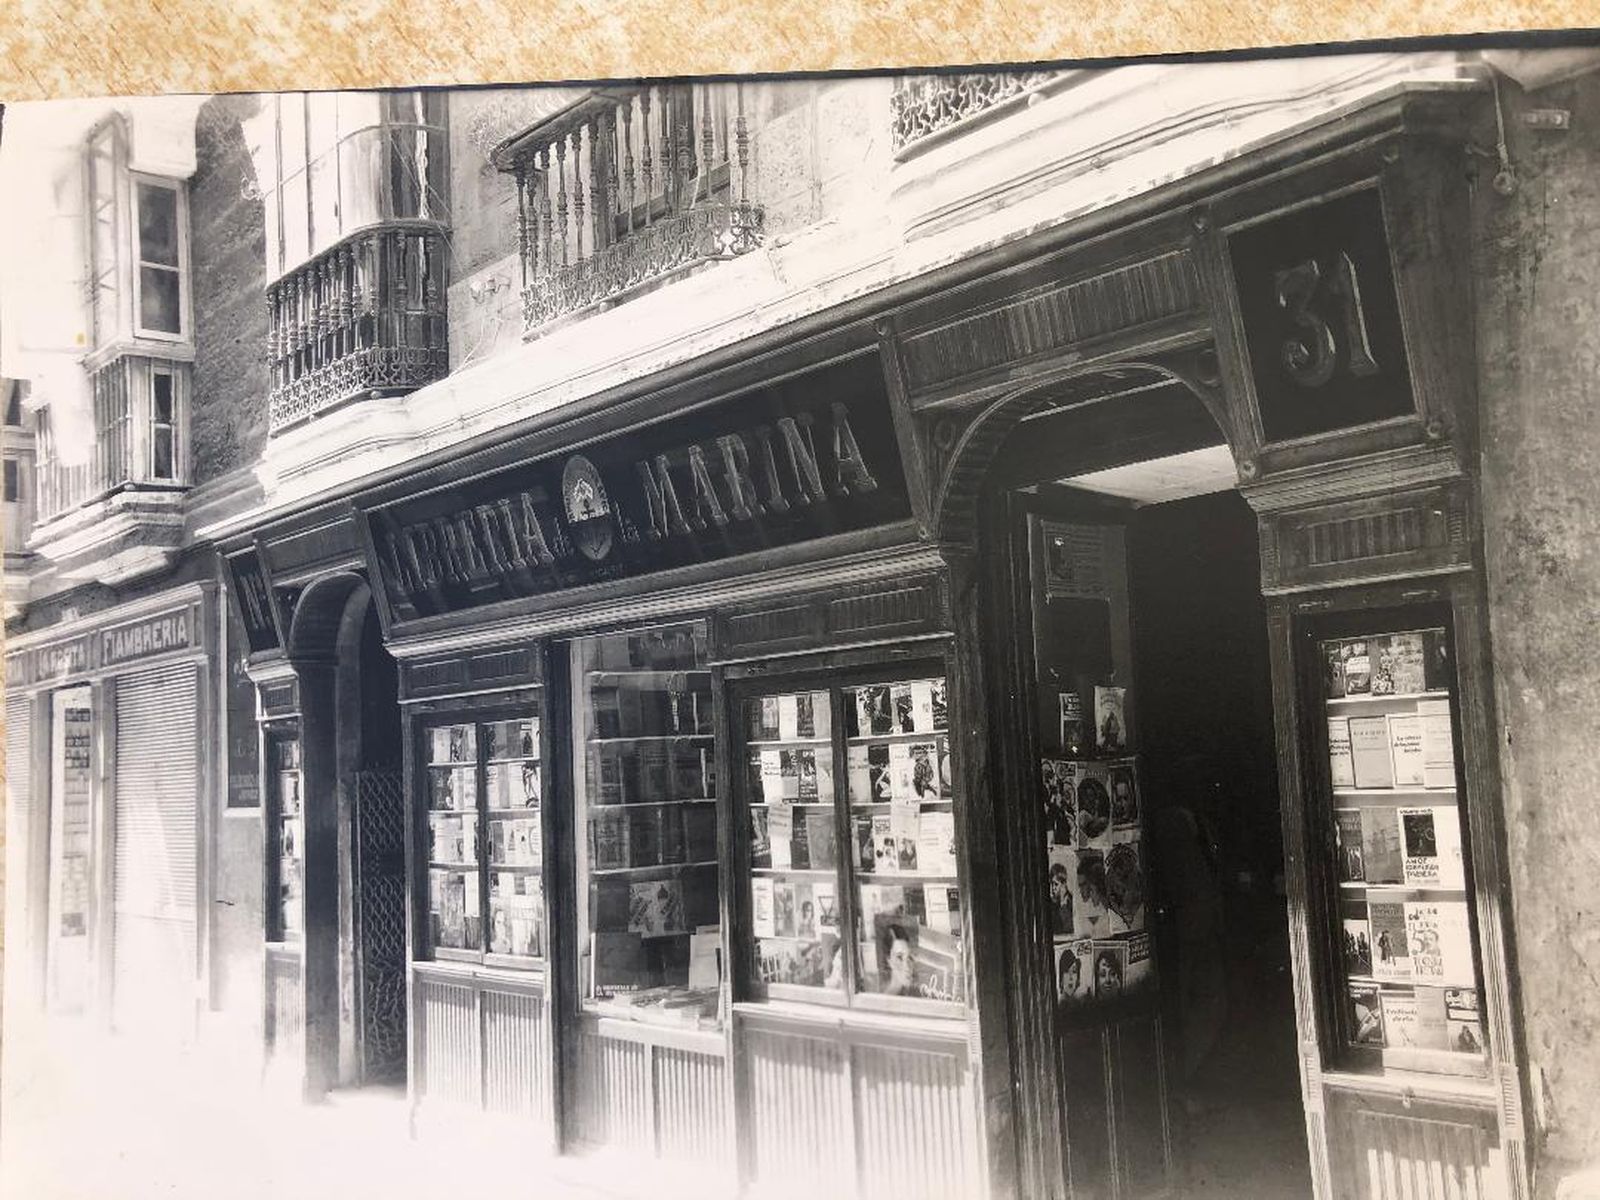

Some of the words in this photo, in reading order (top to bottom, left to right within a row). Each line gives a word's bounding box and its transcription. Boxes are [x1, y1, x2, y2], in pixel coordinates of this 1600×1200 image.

[1274, 250, 1379, 387] 31
[636, 401, 878, 538] MARINA
[103, 615, 188, 666] FIAMBRERIA
